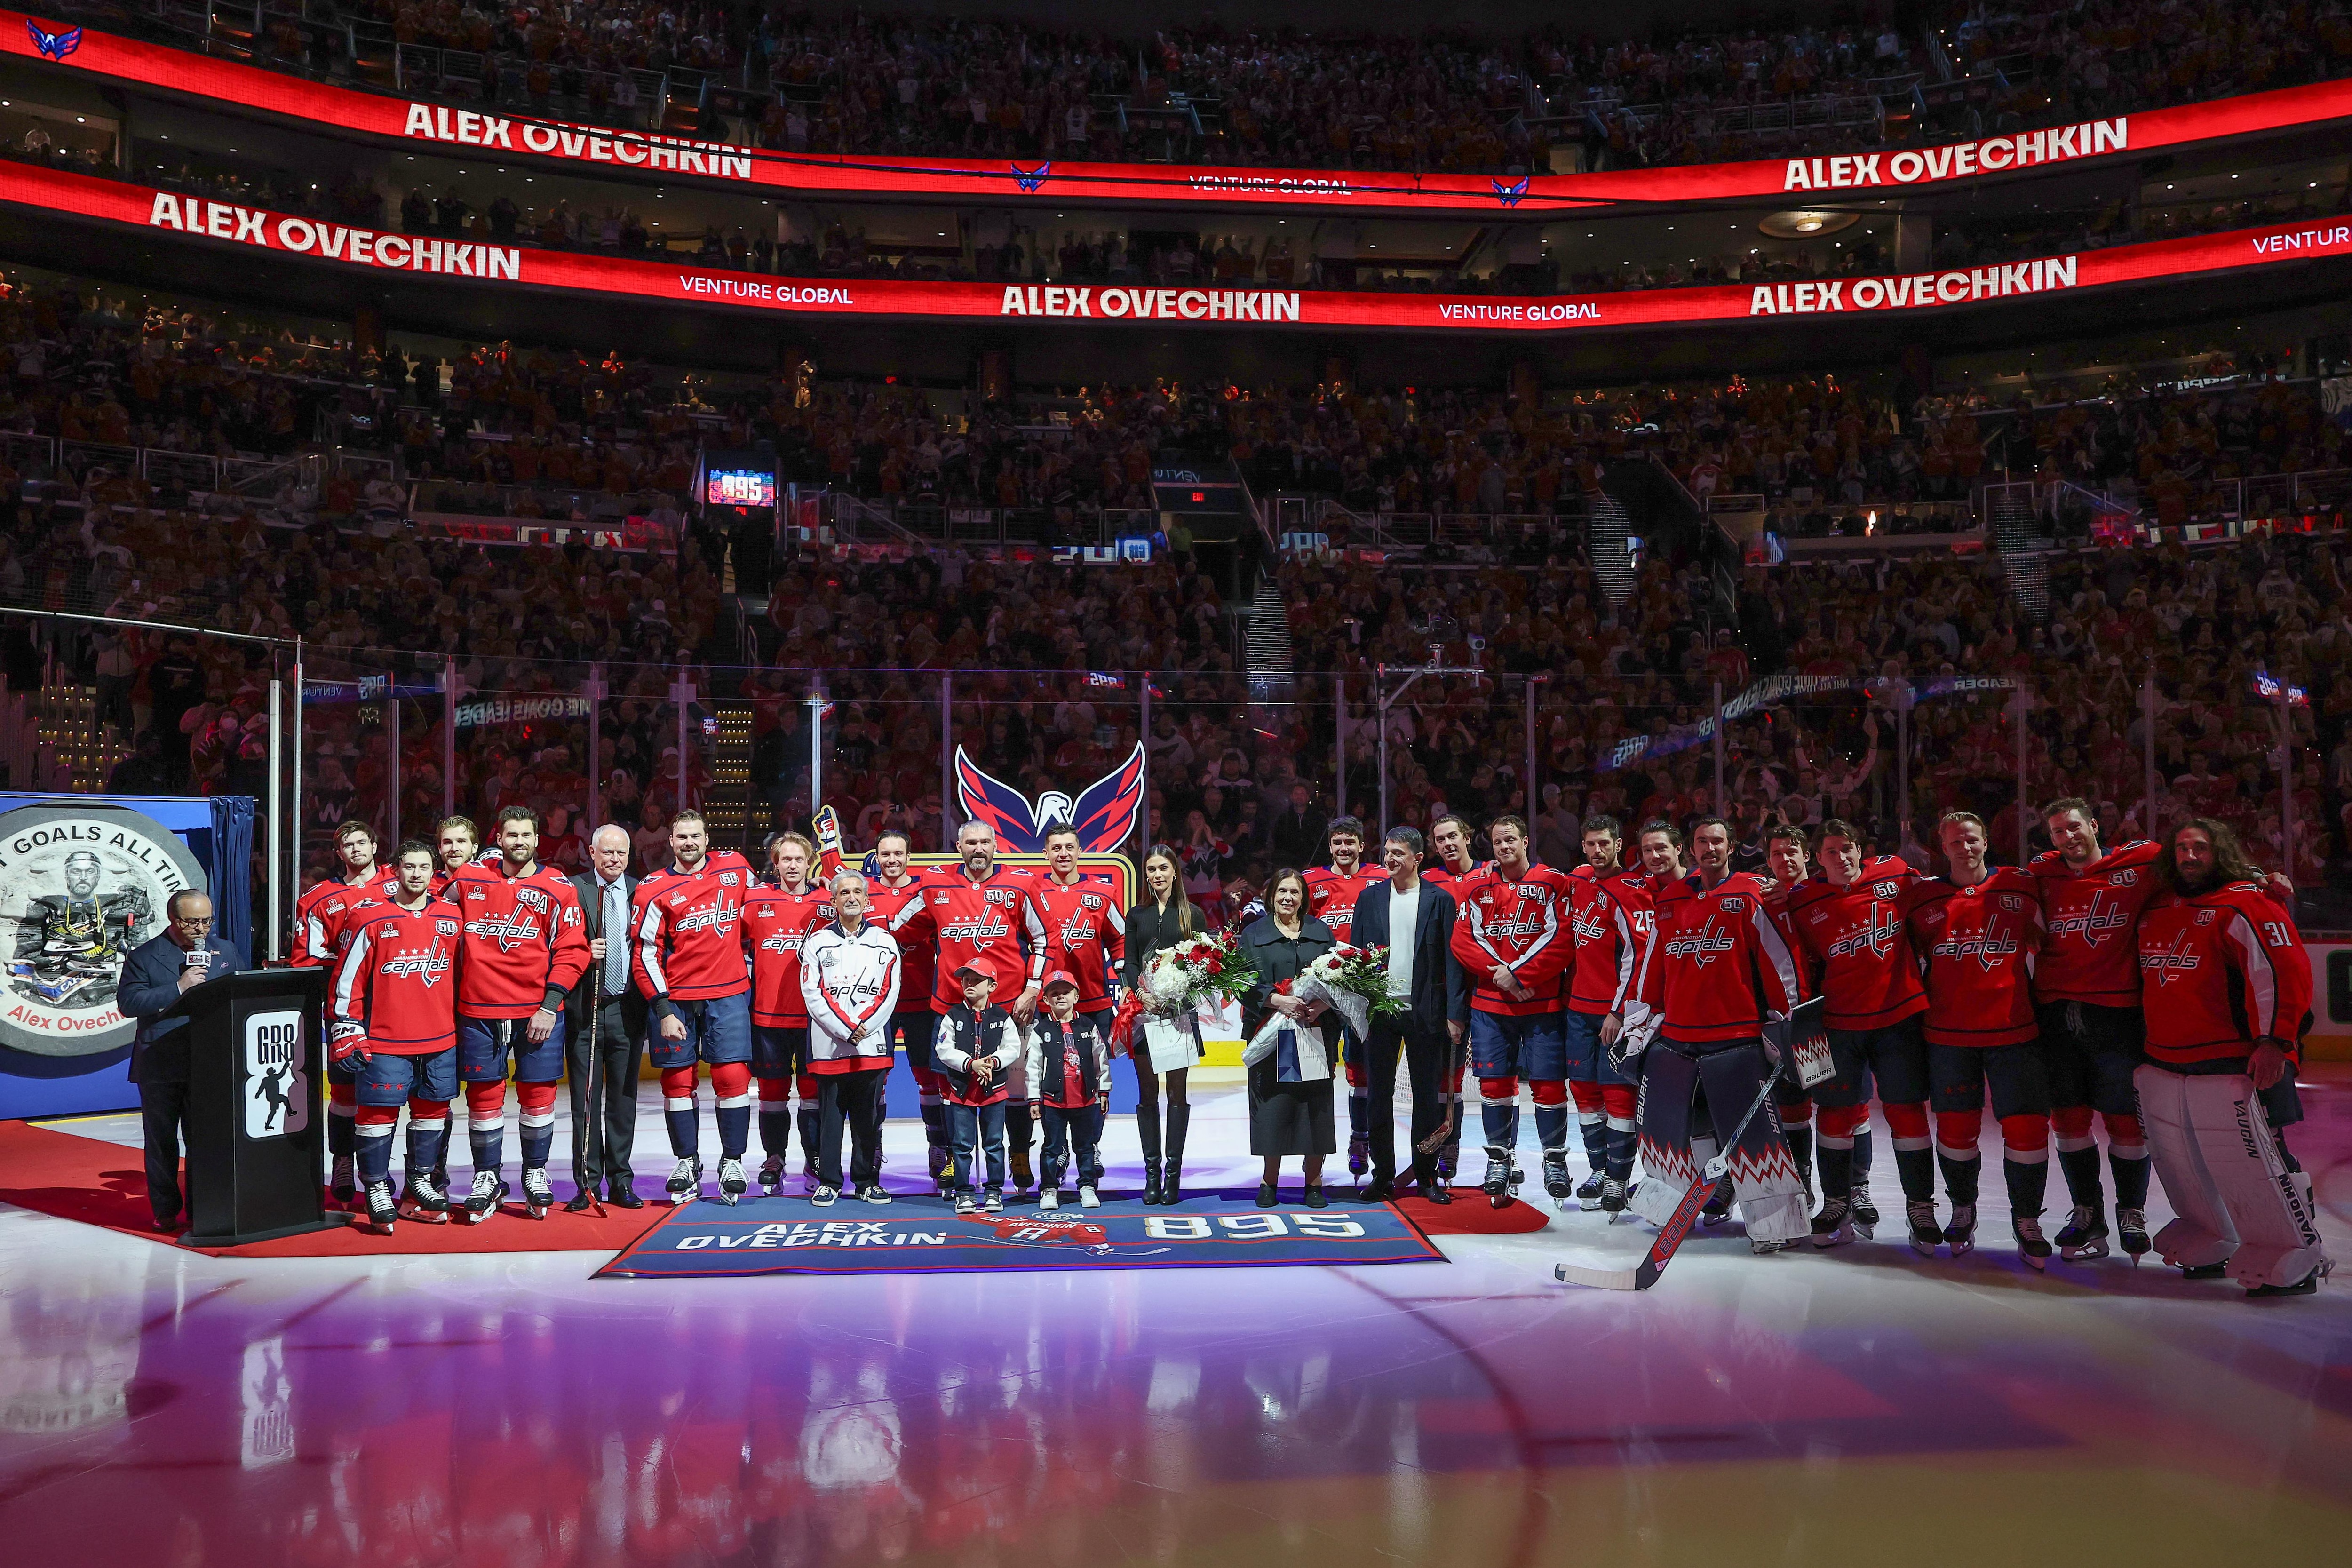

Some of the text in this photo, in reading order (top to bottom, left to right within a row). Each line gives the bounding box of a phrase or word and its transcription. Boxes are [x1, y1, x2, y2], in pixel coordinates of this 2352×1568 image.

[404, 103, 753, 179] ALEX OVECHKIN
[1784, 118, 2128, 190] ALEX OVECHKIN
[1189, 175, 1352, 195] VENTURE GLOBAL
[149, 192, 521, 280] ALEX OVECHKIN
[2252, 226, 2352, 254] VENTUR
[680, 276, 854, 305] VENTURE GLOBAL
[1750, 256, 2077, 315] ALEX OVECHKIN
[1001, 286, 1300, 321] ALEX OVECHKIN
[1439, 302, 1602, 322] VENTURE GLOBAL
[722, 475, 762, 501] 895
[13, 825, 185, 898] GOALS ALL TIM
[720, 873, 738, 886] 50
[2110, 870, 2137, 886] 50
[520, 889, 540, 904] 50
[670, 895, 685, 904] CAESARS
[985, 890, 1004, 902] 50
[1004, 891, 1015, 909] C
[1519, 885, 1537, 899] 50
[1537, 887, 1546, 905] A
[1875, 882, 1897, 898] 50
[534, 894, 548, 914] A
[1082, 894, 1101, 908] 50
[1597, 892, 1607, 909] 50
[1723, 898, 1742, 911] 50
[2002, 896, 2022, 911] 50
[563, 906, 581, 927] 43
[676, 889, 738, 939] capitals
[685, 908, 716, 918] WASHINGTON
[817, 905, 836, 918] 50
[2048, 890, 2129, 949] capitals
[2194, 910, 2216, 925] 50
[437, 921, 457, 934] 50
[464, 903, 540, 954] capitals
[940, 905, 1009, 953] capitals
[1828, 901, 1902, 960] capitals
[1836, 926, 1871, 941] WASHINGTON
[2263, 921, 2293, 947] 31
[1665, 914, 1735, 969] capitals
[1932, 914, 2018, 972] capitals
[381, 936, 450, 989] capitals
[878, 950, 887, 965] C
[2140, 928, 2201, 987] apitals
[7, 1005, 52, 1029] Alex
[956, 1020, 964, 1032] 8
[257, 1023, 294, 1065] GR8
[1044, 1031, 1051, 1043] 8
[1806, 1067, 1832, 1083] BAUER
[1636, 1075, 1650, 1126] BAUER
[2234, 1099, 2261, 1159] VAUGHN
[2278, 1173, 2317, 1246] VAUGHN
[753, 1222, 889, 1234] ALEX
[1144, 1214, 1366, 1239] 895
[1659, 1186, 1706, 1256] BAUER
[675, 1231, 946, 1250] OVECHKIN
